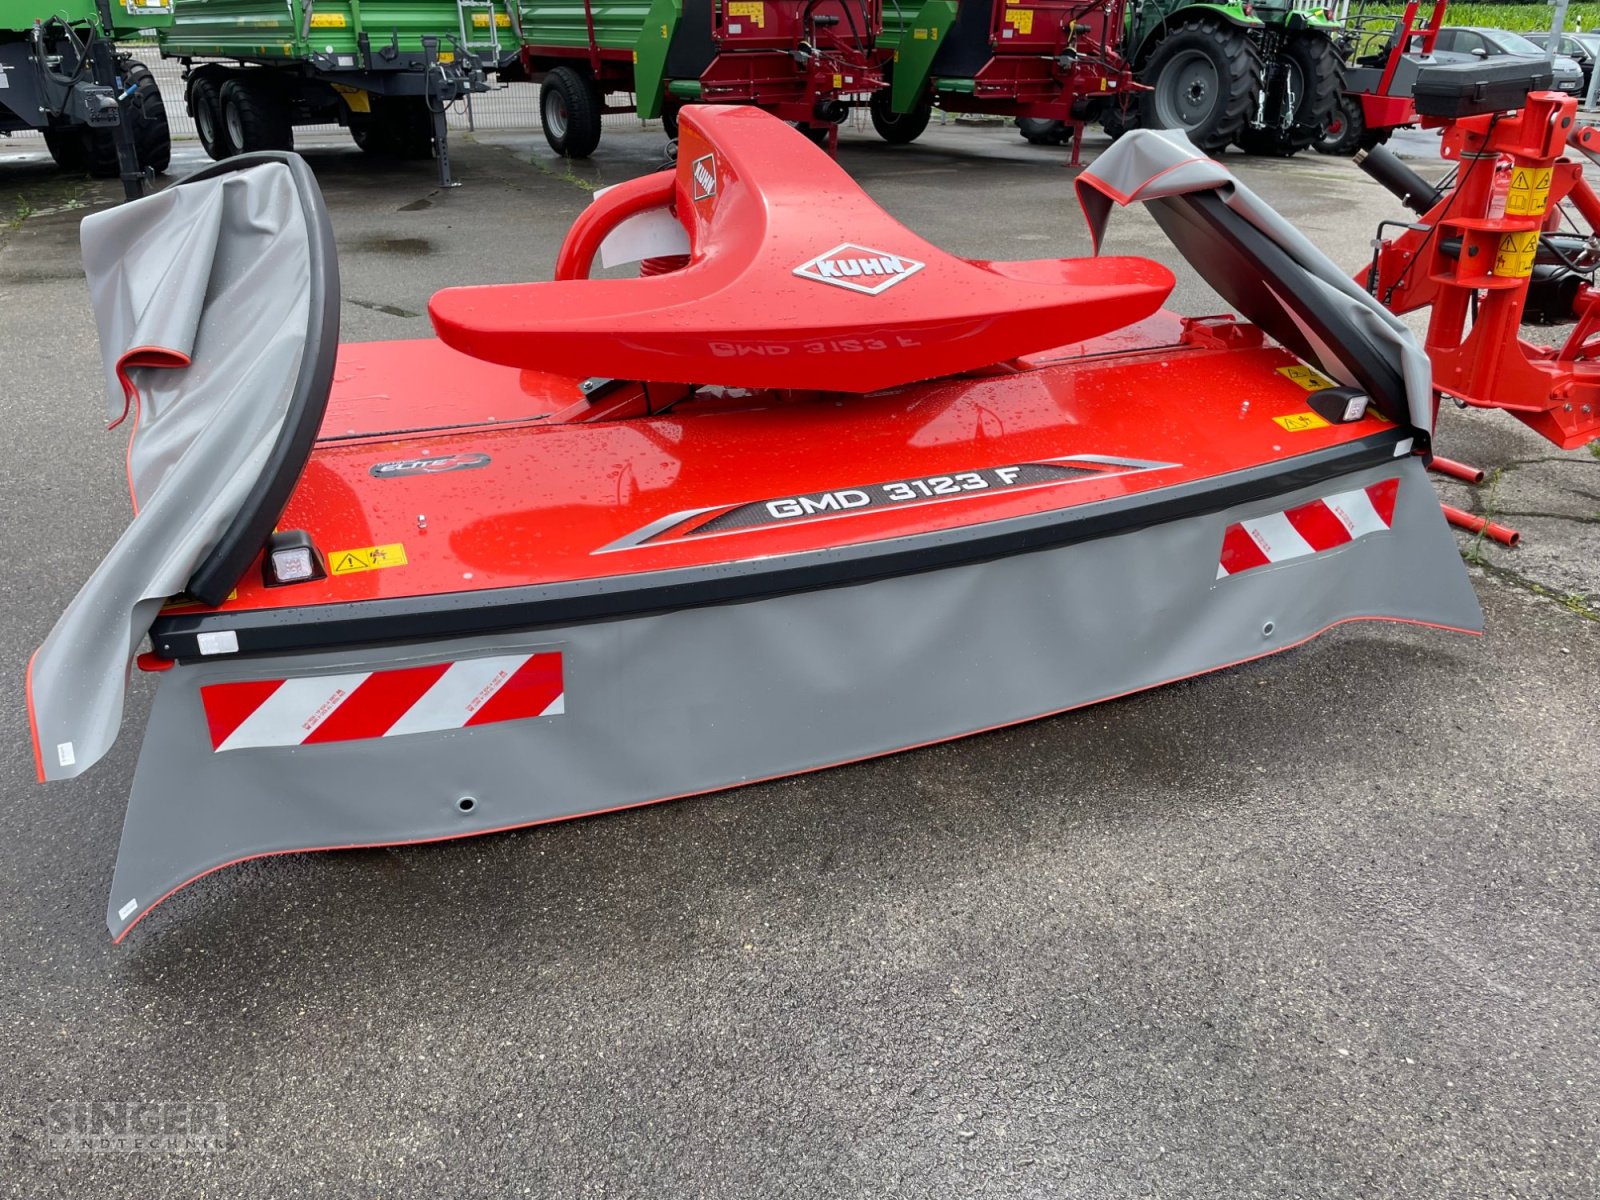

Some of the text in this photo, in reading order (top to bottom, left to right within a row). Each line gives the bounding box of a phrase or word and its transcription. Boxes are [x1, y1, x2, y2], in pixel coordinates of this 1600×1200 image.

[694, 160, 715, 195] KUHN
[815, 256, 904, 277] KUHN
[380, 459, 447, 472] ELITE
[766, 466, 1020, 518] GMD 3123 F
